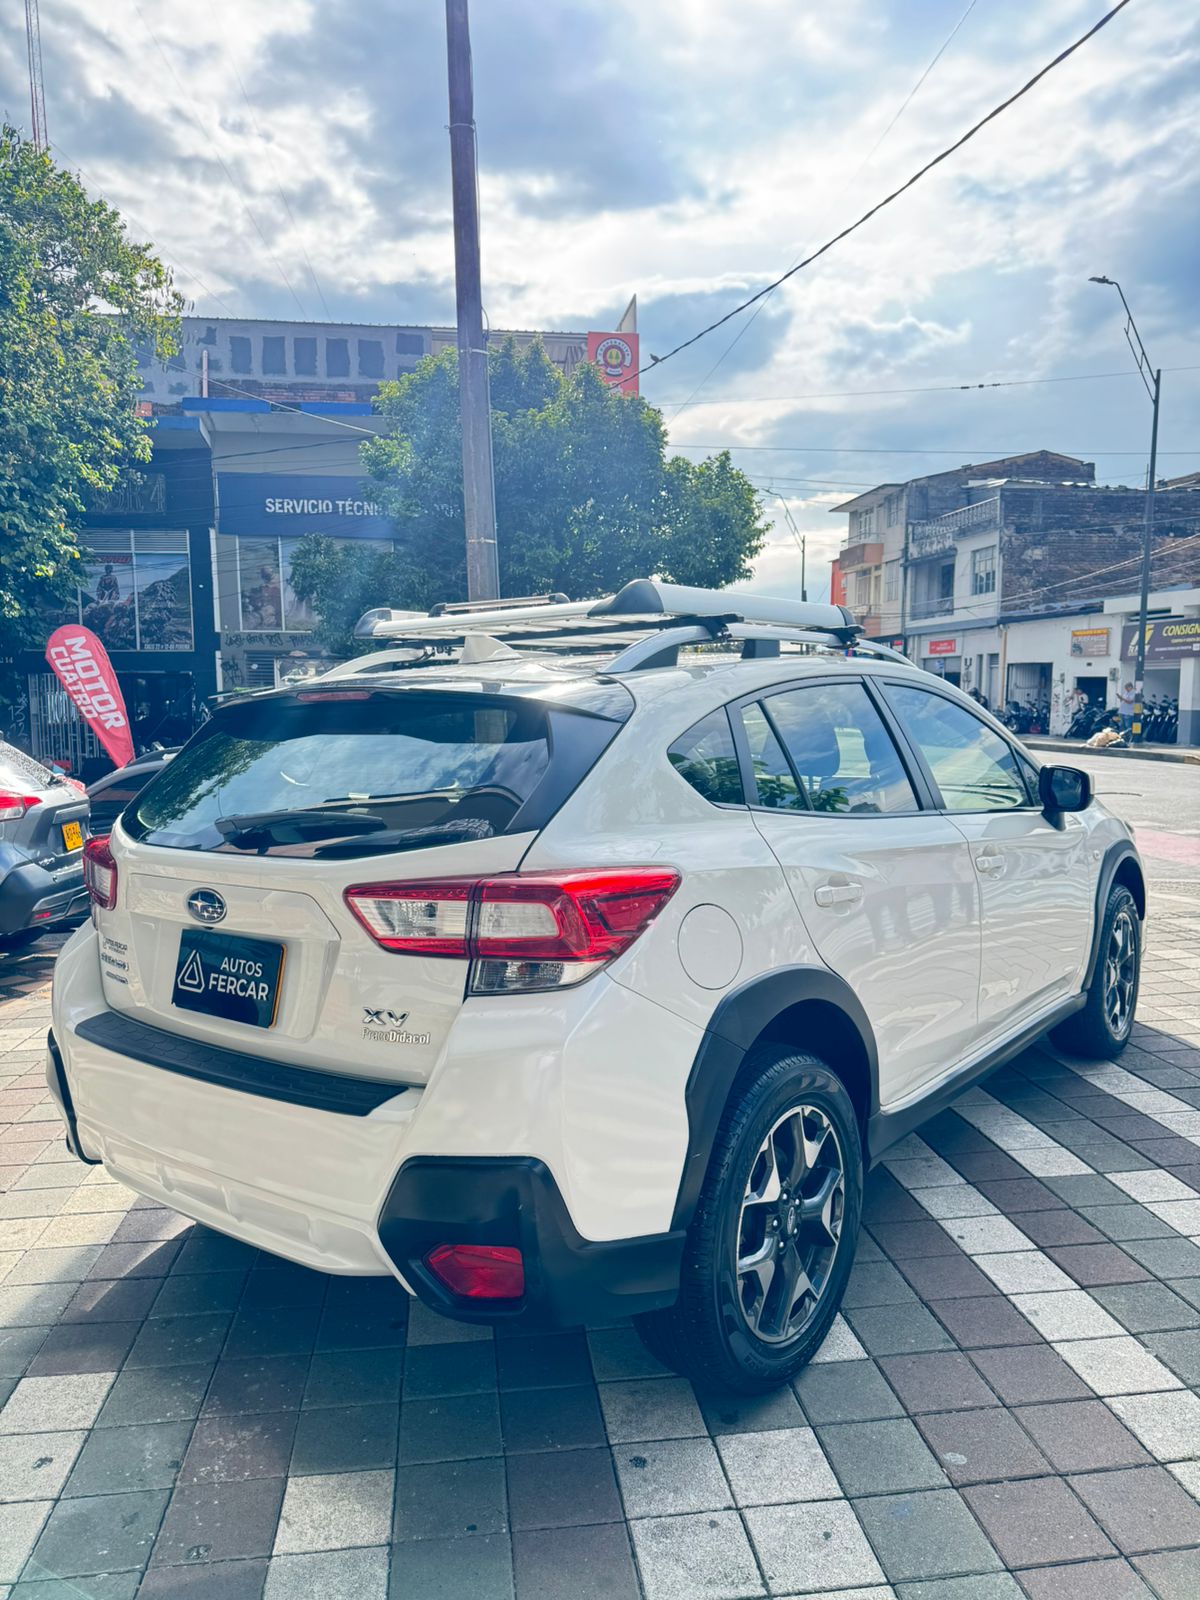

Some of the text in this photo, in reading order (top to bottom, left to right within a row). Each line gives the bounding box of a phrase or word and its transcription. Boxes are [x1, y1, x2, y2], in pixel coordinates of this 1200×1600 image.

[265, 498, 333, 514] SERVICIO
[50, 646, 98, 719] CUATRO
[64, 636, 127, 730] MOTOR
[220, 956, 263, 977] AUTOS
[208, 972, 269, 1001] FERCAR
[362, 1007, 409, 1028] XV
[362, 1026, 431, 1045] PracoDidacol
